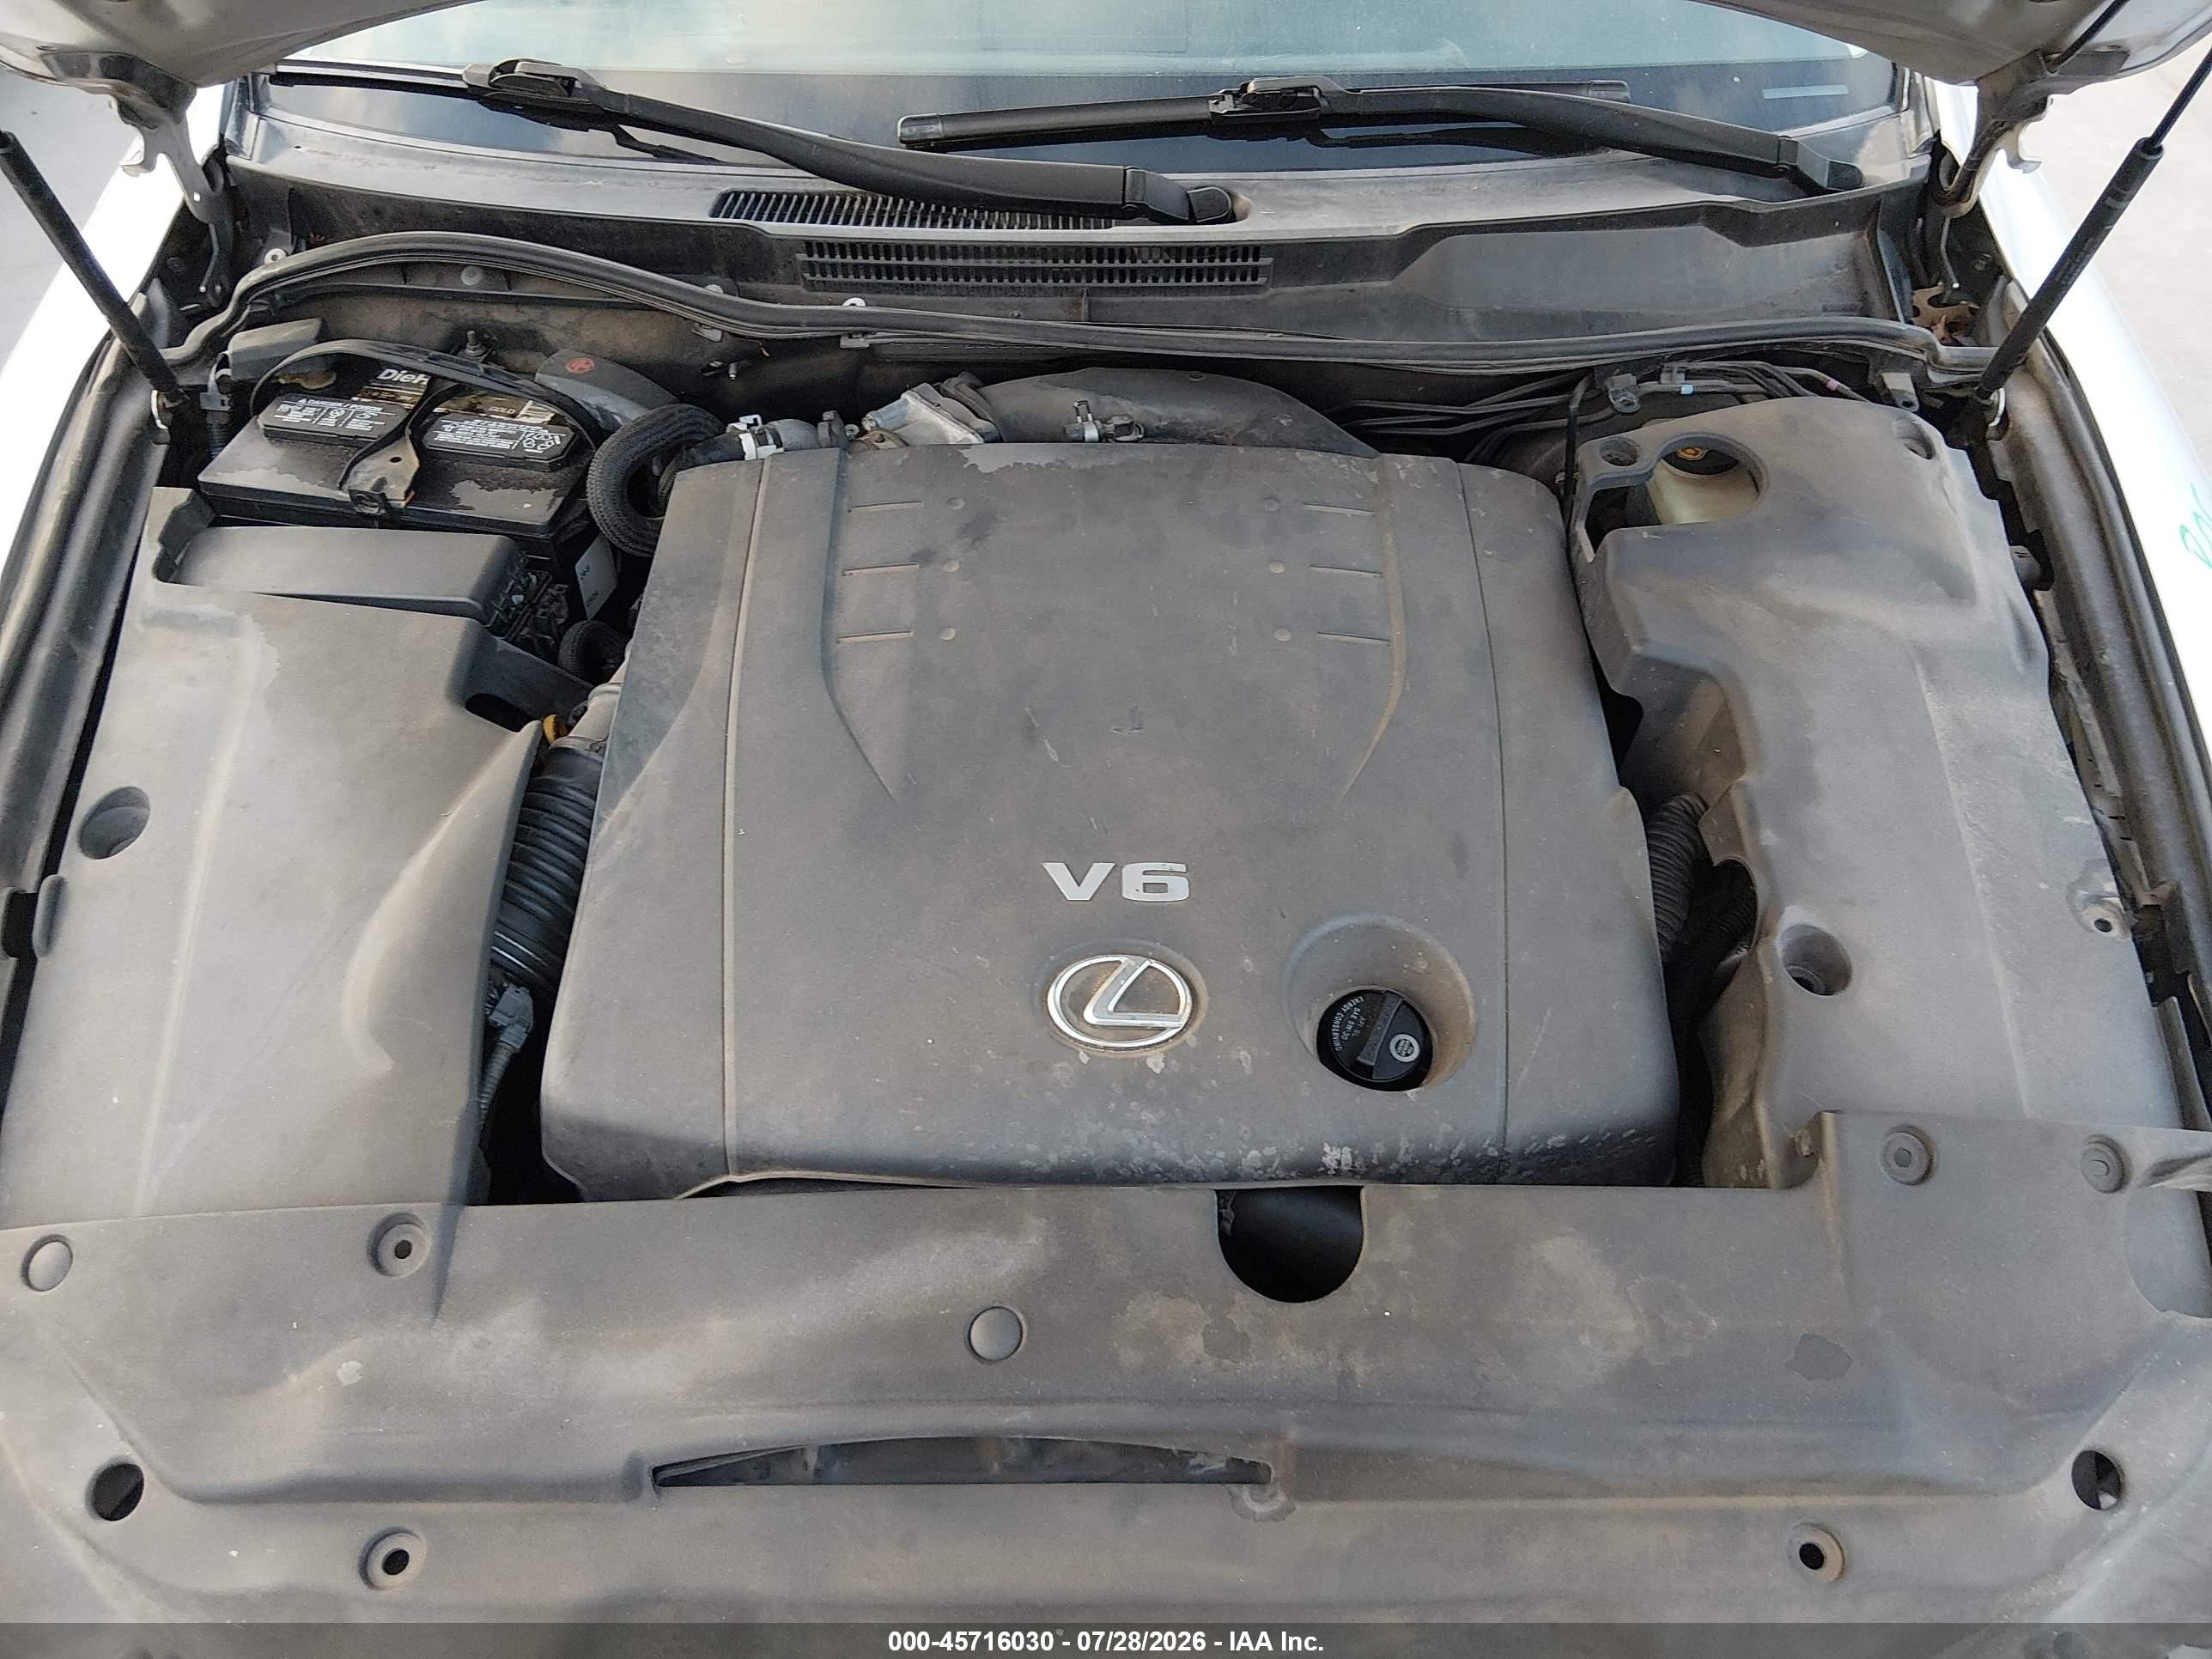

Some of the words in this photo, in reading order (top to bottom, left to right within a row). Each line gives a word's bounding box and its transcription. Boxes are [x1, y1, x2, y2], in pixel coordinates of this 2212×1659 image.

[1042, 861, 1190, 902] V6
[1340, 995, 1365, 1013] ENERGY
[1349, 1006, 1361, 1020] SAE
